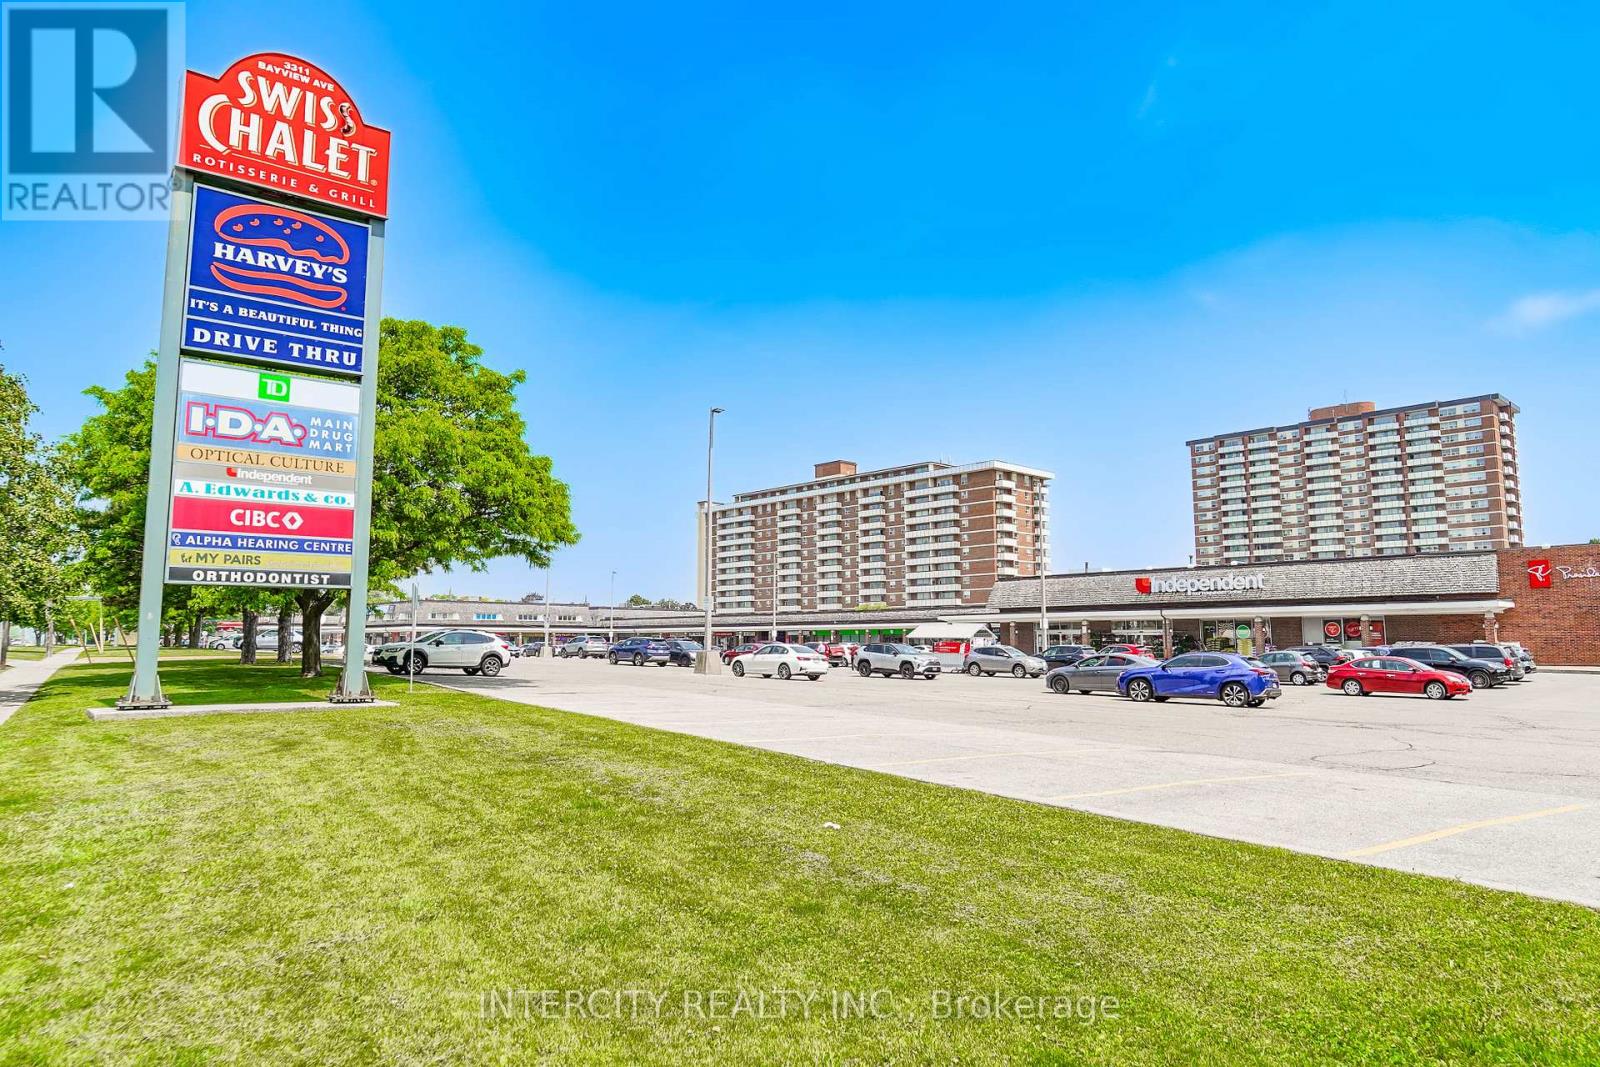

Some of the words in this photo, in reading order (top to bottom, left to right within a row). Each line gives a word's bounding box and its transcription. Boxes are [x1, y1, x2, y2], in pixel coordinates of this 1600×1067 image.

[258, 61, 311, 84] BAYVIEW
[312, 79, 335, 92] AVE
[283, 62, 310, 76] 3311
[237, 70, 356, 137] SWISS
[198, 94, 377, 185] CHALET
[193, 153, 298, 188] ROTISSERIE
[309, 183, 319, 194] &
[329, 189, 376, 208] GRILL
[213, 241, 348, 284] HARVEY'S
[190, 299, 219, 313] IT'S
[223, 305, 234, 315] A
[238, 307, 317, 330] BEAUTIFUL
[321, 322, 363, 338] THING
[192, 327, 278, 354] DRIVE
[288, 342, 357, 366] THRU
[261, 379, 288, 397] TD
[310, 416, 353, 431] MAIN
[310, 429, 353, 442] DRUG
[309, 442, 352, 453] MART
[190, 447, 265, 466] OPTICAL
[270, 455, 345, 474] CULTURE
[180, 481, 199, 494] A.
[204, 483, 300, 502] Edwards
[304, 491, 318, 503] &
[230, 508, 280, 528] CIBC
[185, 535, 232, 547] ALPHA
[238, 538, 299, 551] HEARING
[303, 541, 352, 553] CENTRE
[196, 552, 219, 563] MY
[223, 554, 261, 565] PAIRS
[192, 570, 331, 585] ORTHODONTIST
